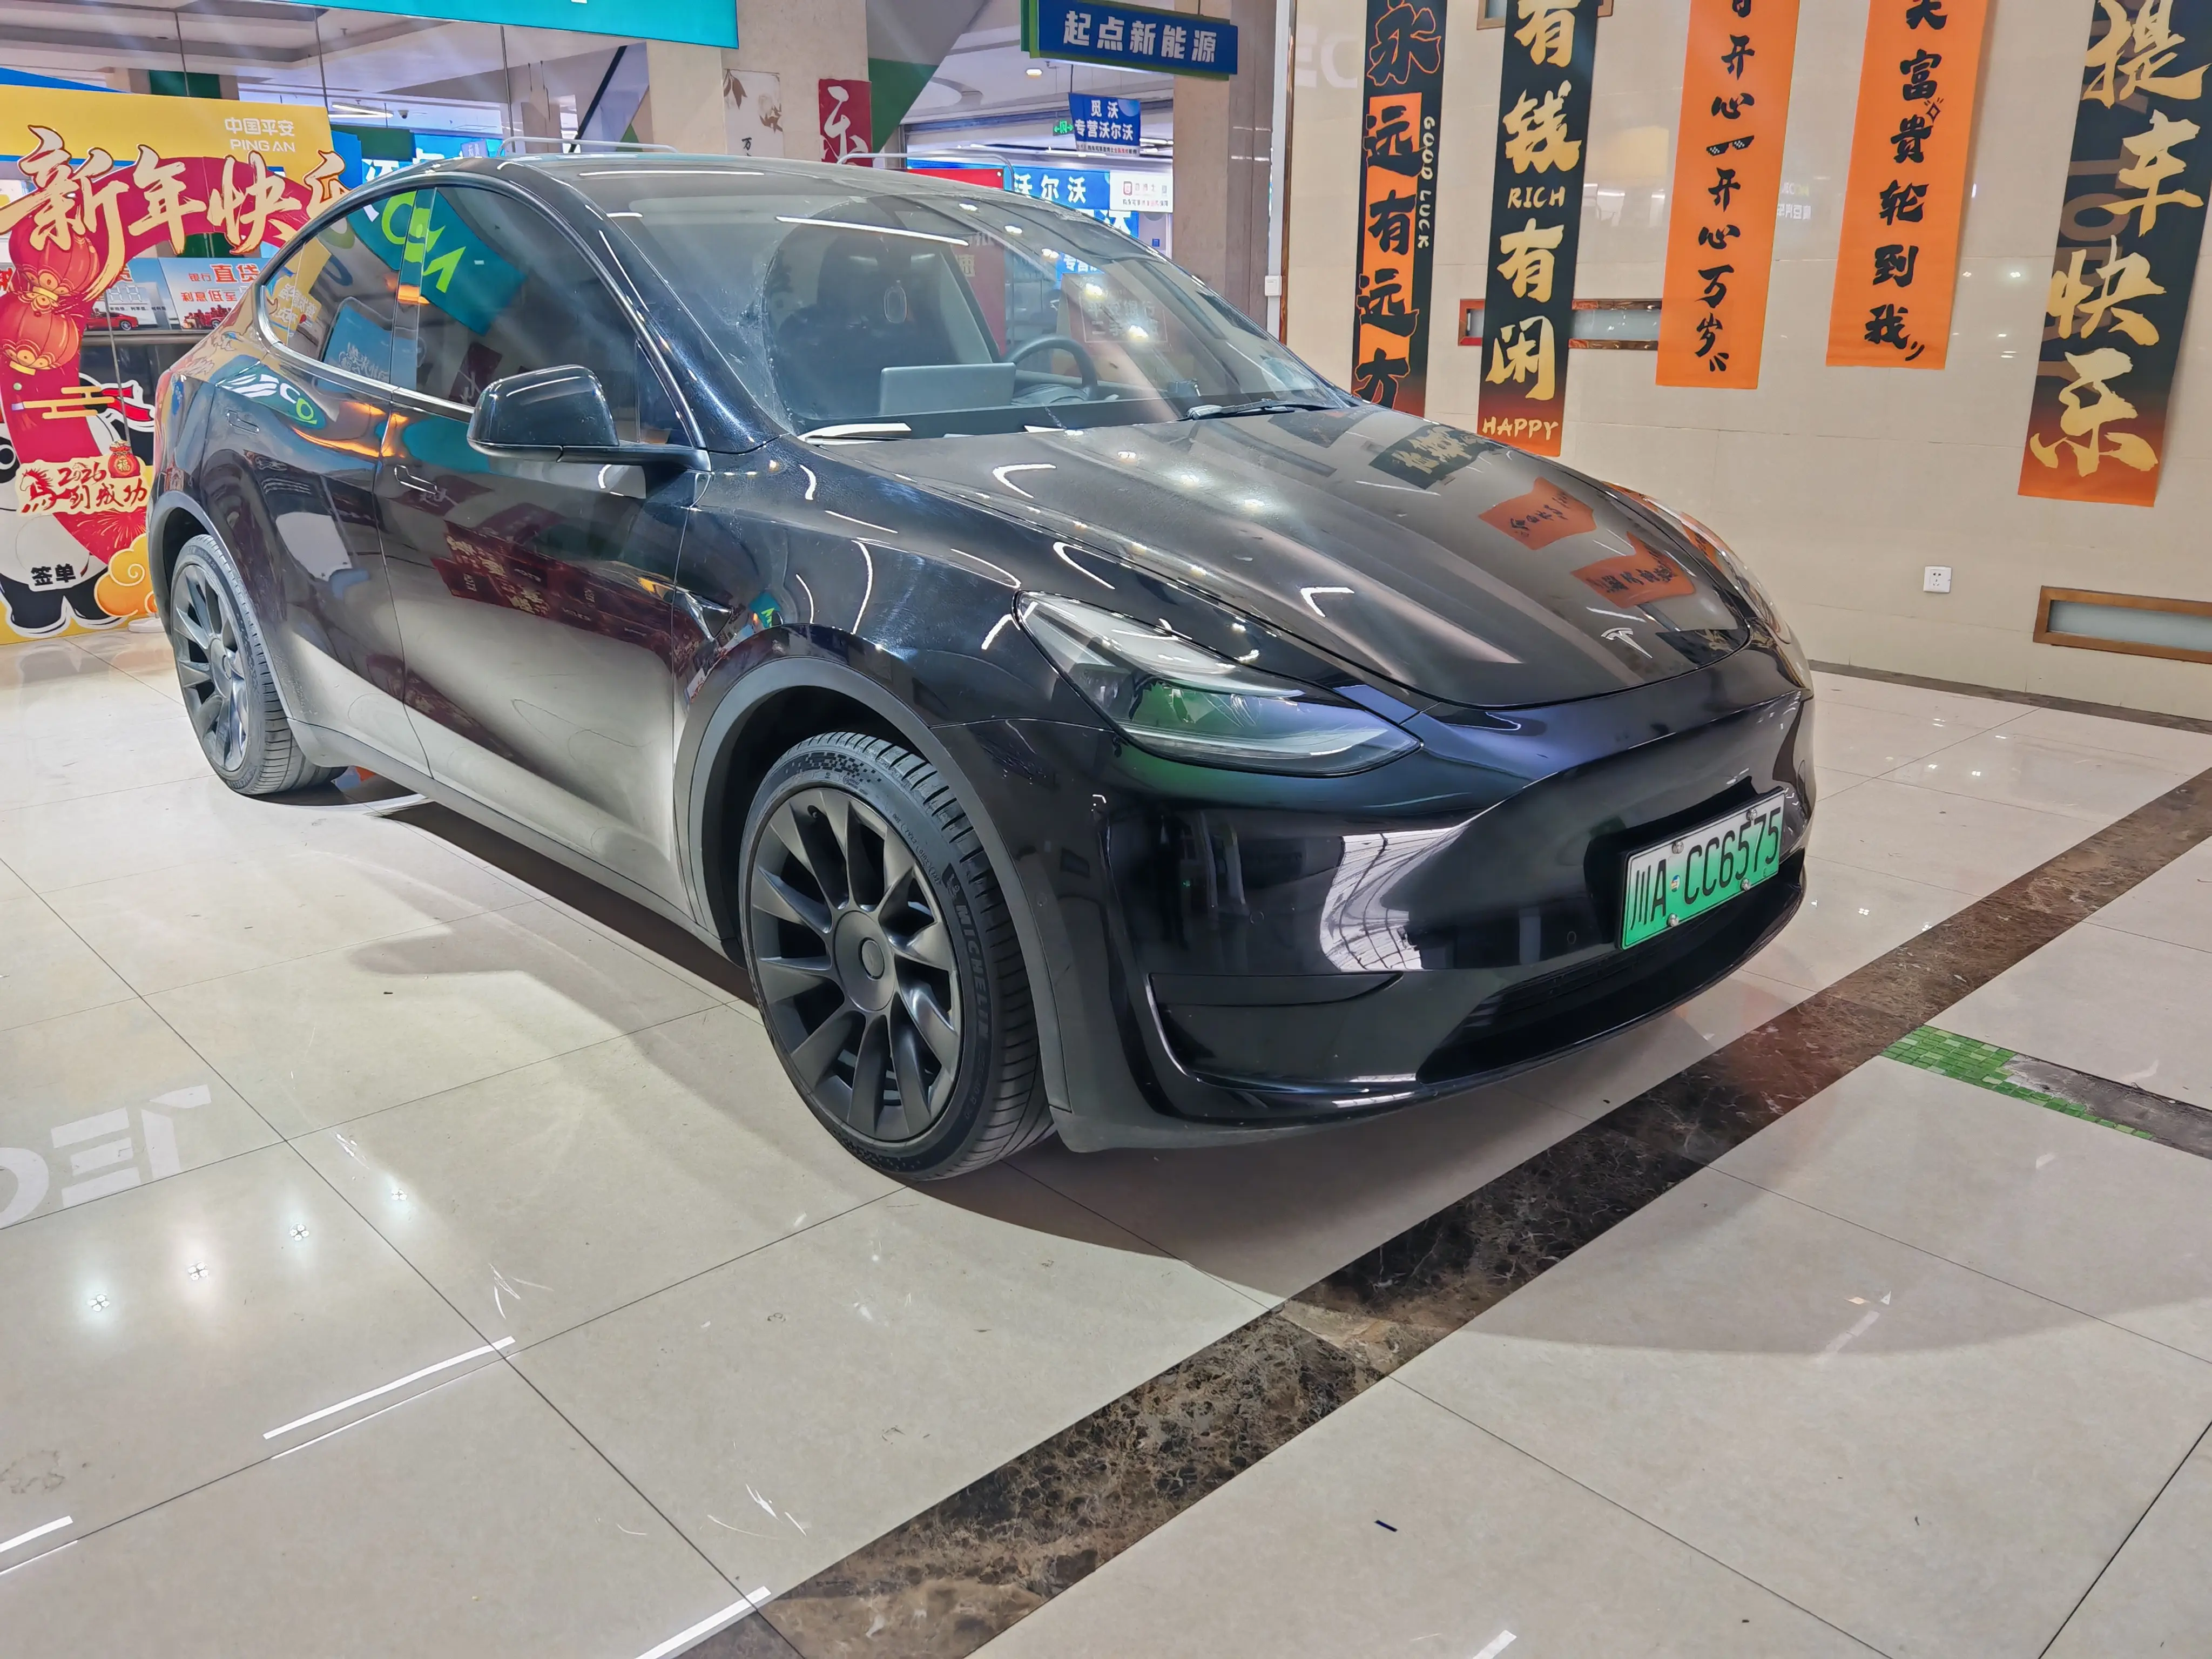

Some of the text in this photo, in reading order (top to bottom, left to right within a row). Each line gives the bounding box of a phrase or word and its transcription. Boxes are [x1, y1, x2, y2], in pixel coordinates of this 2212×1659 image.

[1062, 10, 1217, 63] 起点新能源
[1090, 99, 1119, 119] 觅沃
[224, 117, 295, 137] 中国平安
[1074, 118, 1134, 141] 专营沃尔沃
[1013, 173, 1087, 204] 沃尔沃
[1417, 116, 1435, 248] GOOD LUCK
[1507, 186, 1566, 208] RICH
[2030, 0, 2211, 476] 提车快乐
[180, 289, 238, 302] 利息低至
[1482, 416, 1559, 440] HAPPY
[116, 458, 132, 473] 福
[31, 563, 77, 586] 签单
[955, 905, 989, 1040] MICHELIN
